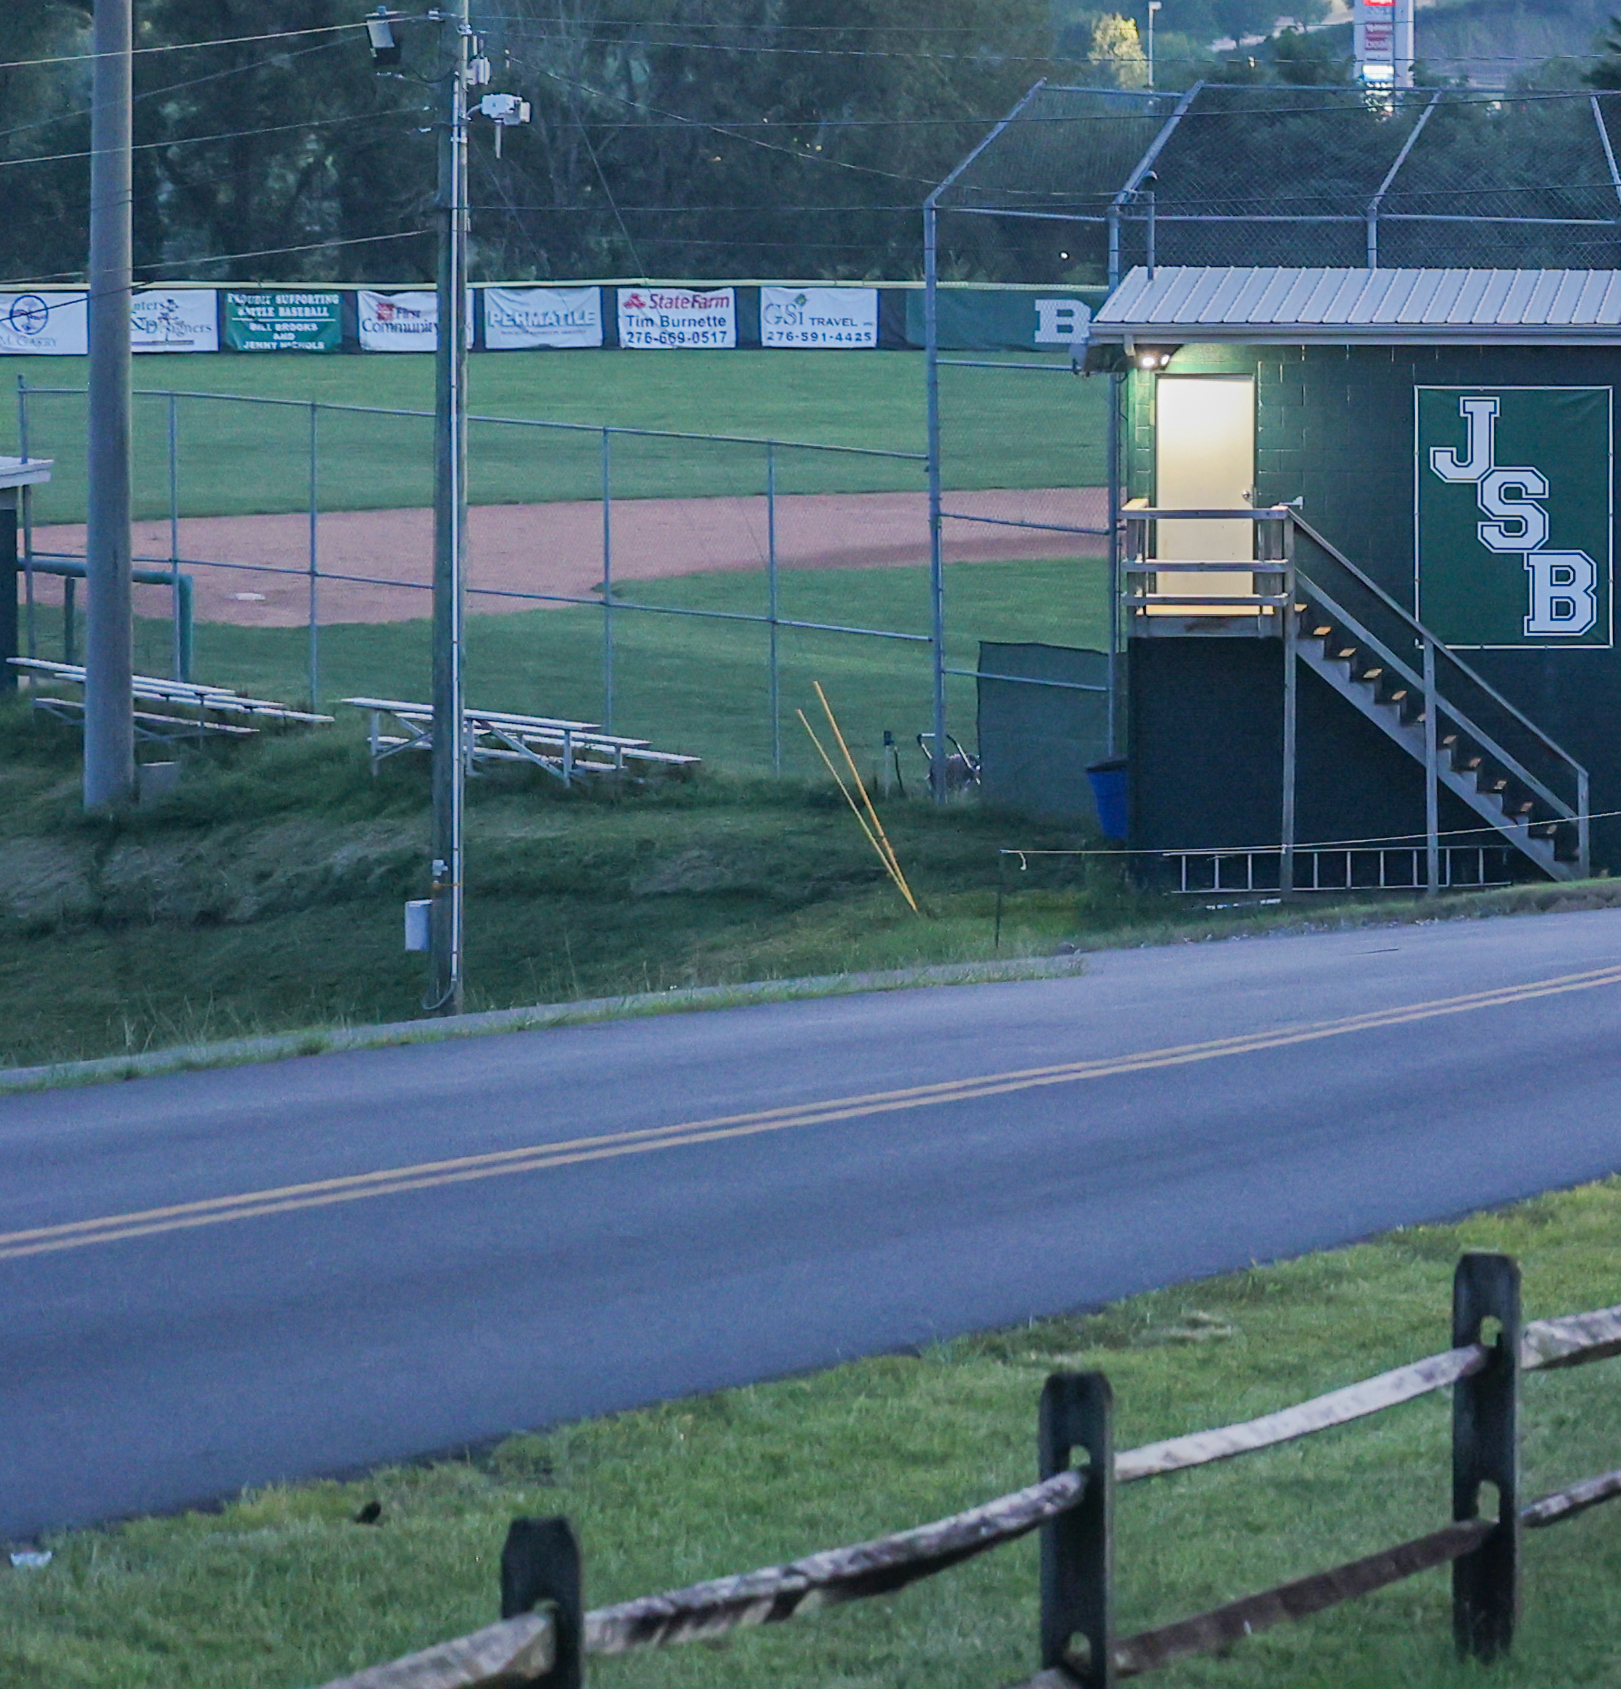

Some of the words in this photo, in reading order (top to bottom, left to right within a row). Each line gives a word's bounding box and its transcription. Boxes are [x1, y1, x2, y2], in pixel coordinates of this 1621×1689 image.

[275, 294, 340, 305] SUPPORTING
[488, 310, 596, 328] PERMATILE
[625, 315, 654, 327] Tim
[660, 315, 727, 328] Burnette
[808, 317, 859, 327] TRAVEL
[626, 331, 728, 344] 276-669-0517
[766, 331, 872, 342] 276-591-4425
